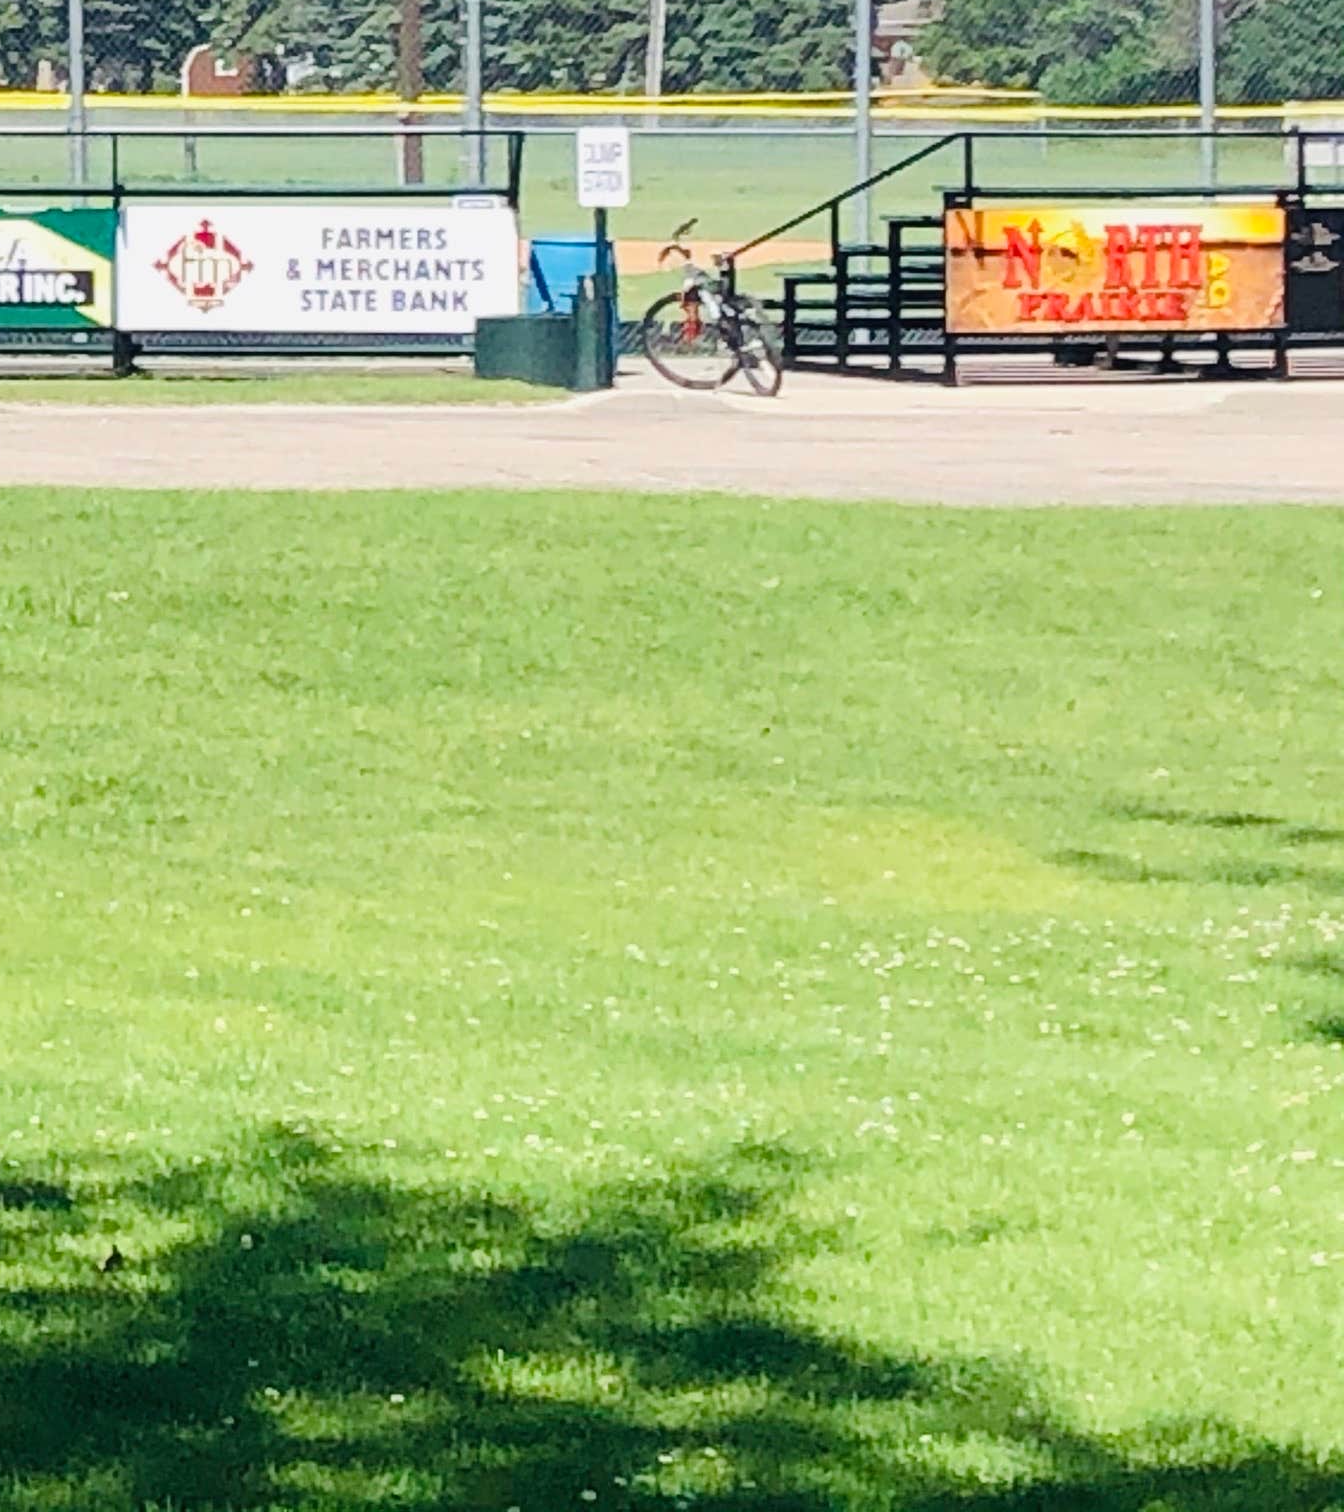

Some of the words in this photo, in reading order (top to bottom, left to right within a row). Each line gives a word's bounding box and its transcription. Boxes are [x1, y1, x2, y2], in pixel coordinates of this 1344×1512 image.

[320, 228, 448, 250] FARMERS
[286, 259, 302, 281] &
[316, 259, 485, 281] MERCHANTS
[22, 273, 87, 304] INC.
[300, 290, 378, 312] STATE
[391, 290, 469, 312] BANK
[1017, 292, 1187, 322] PRAIRIE
